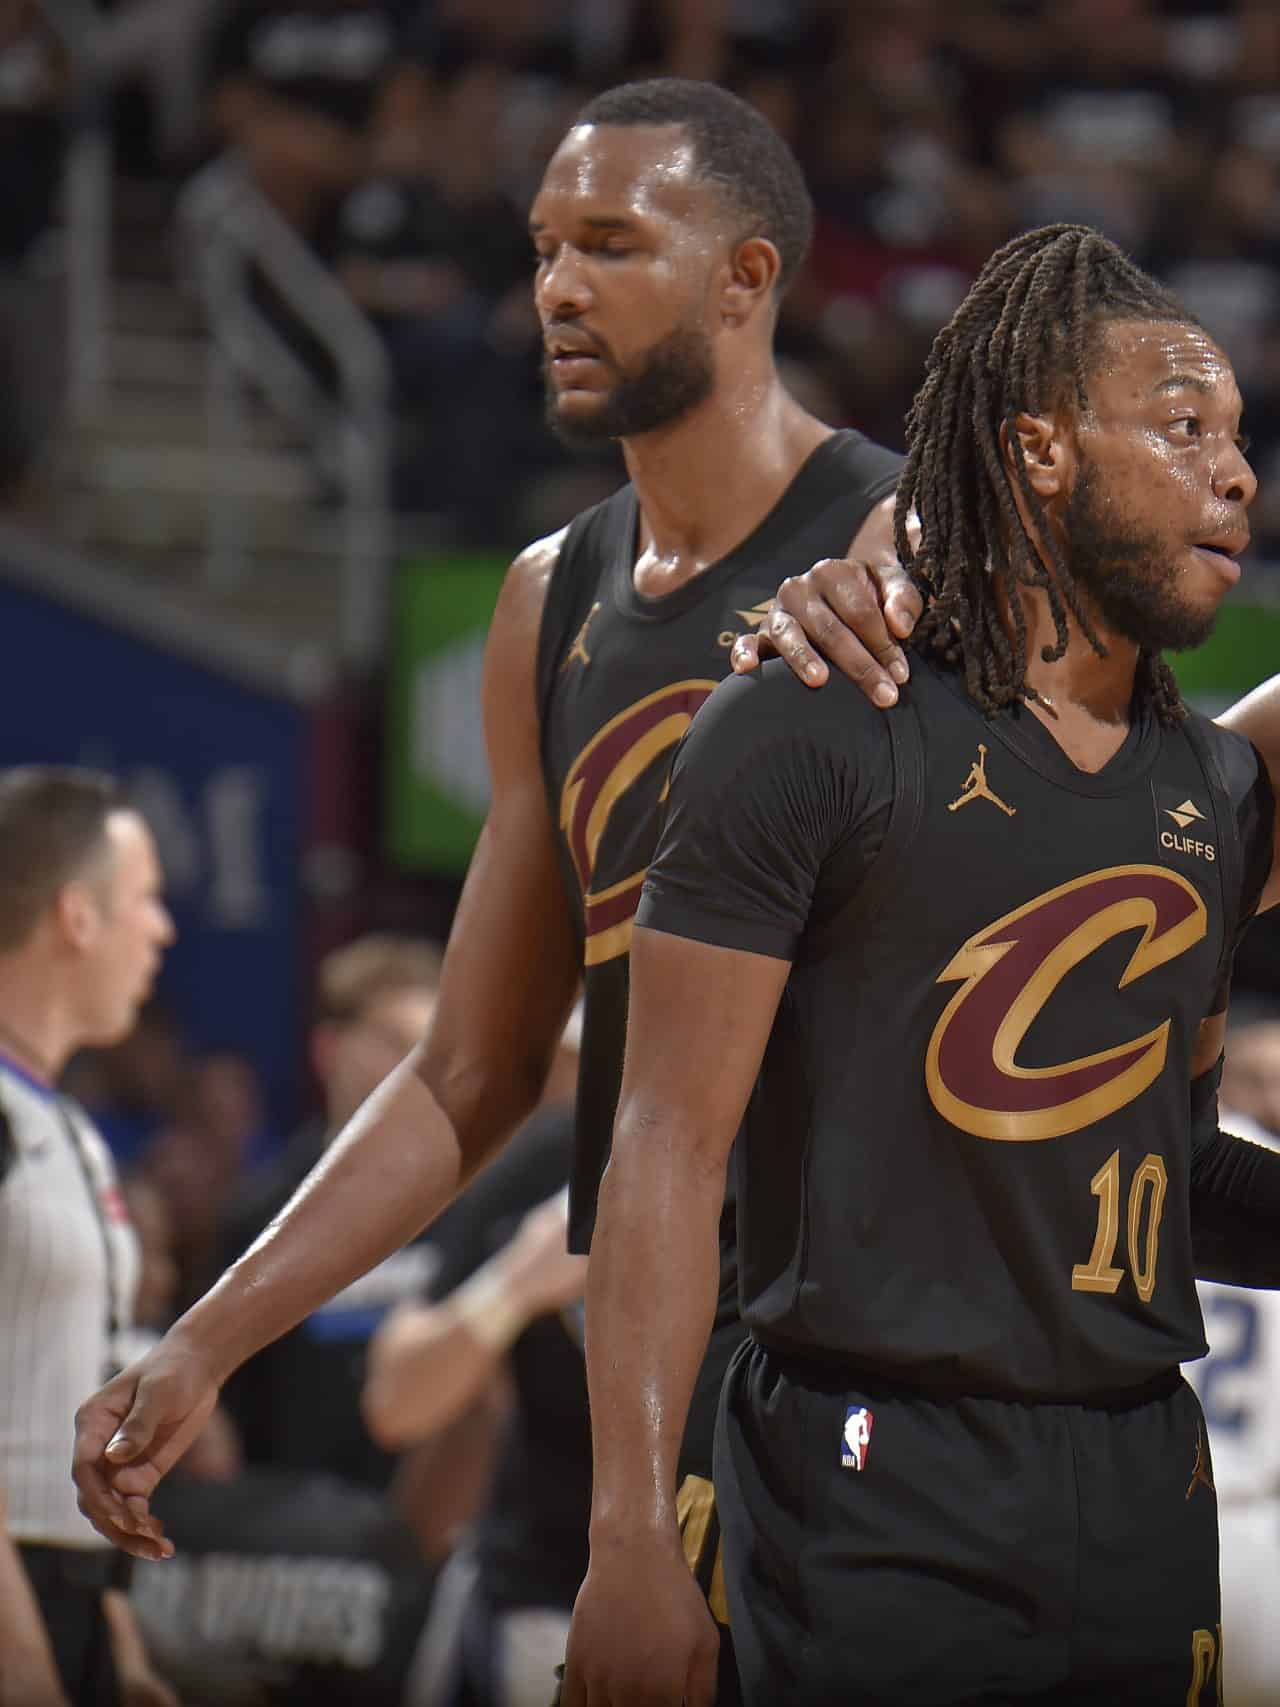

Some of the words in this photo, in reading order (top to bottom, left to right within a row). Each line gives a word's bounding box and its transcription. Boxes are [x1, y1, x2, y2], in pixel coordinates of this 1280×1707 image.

[1160, 831, 1216, 861] CLIFFS
[925, 864, 1208, 1142] C
[1072, 1149, 1168, 1303] 10
